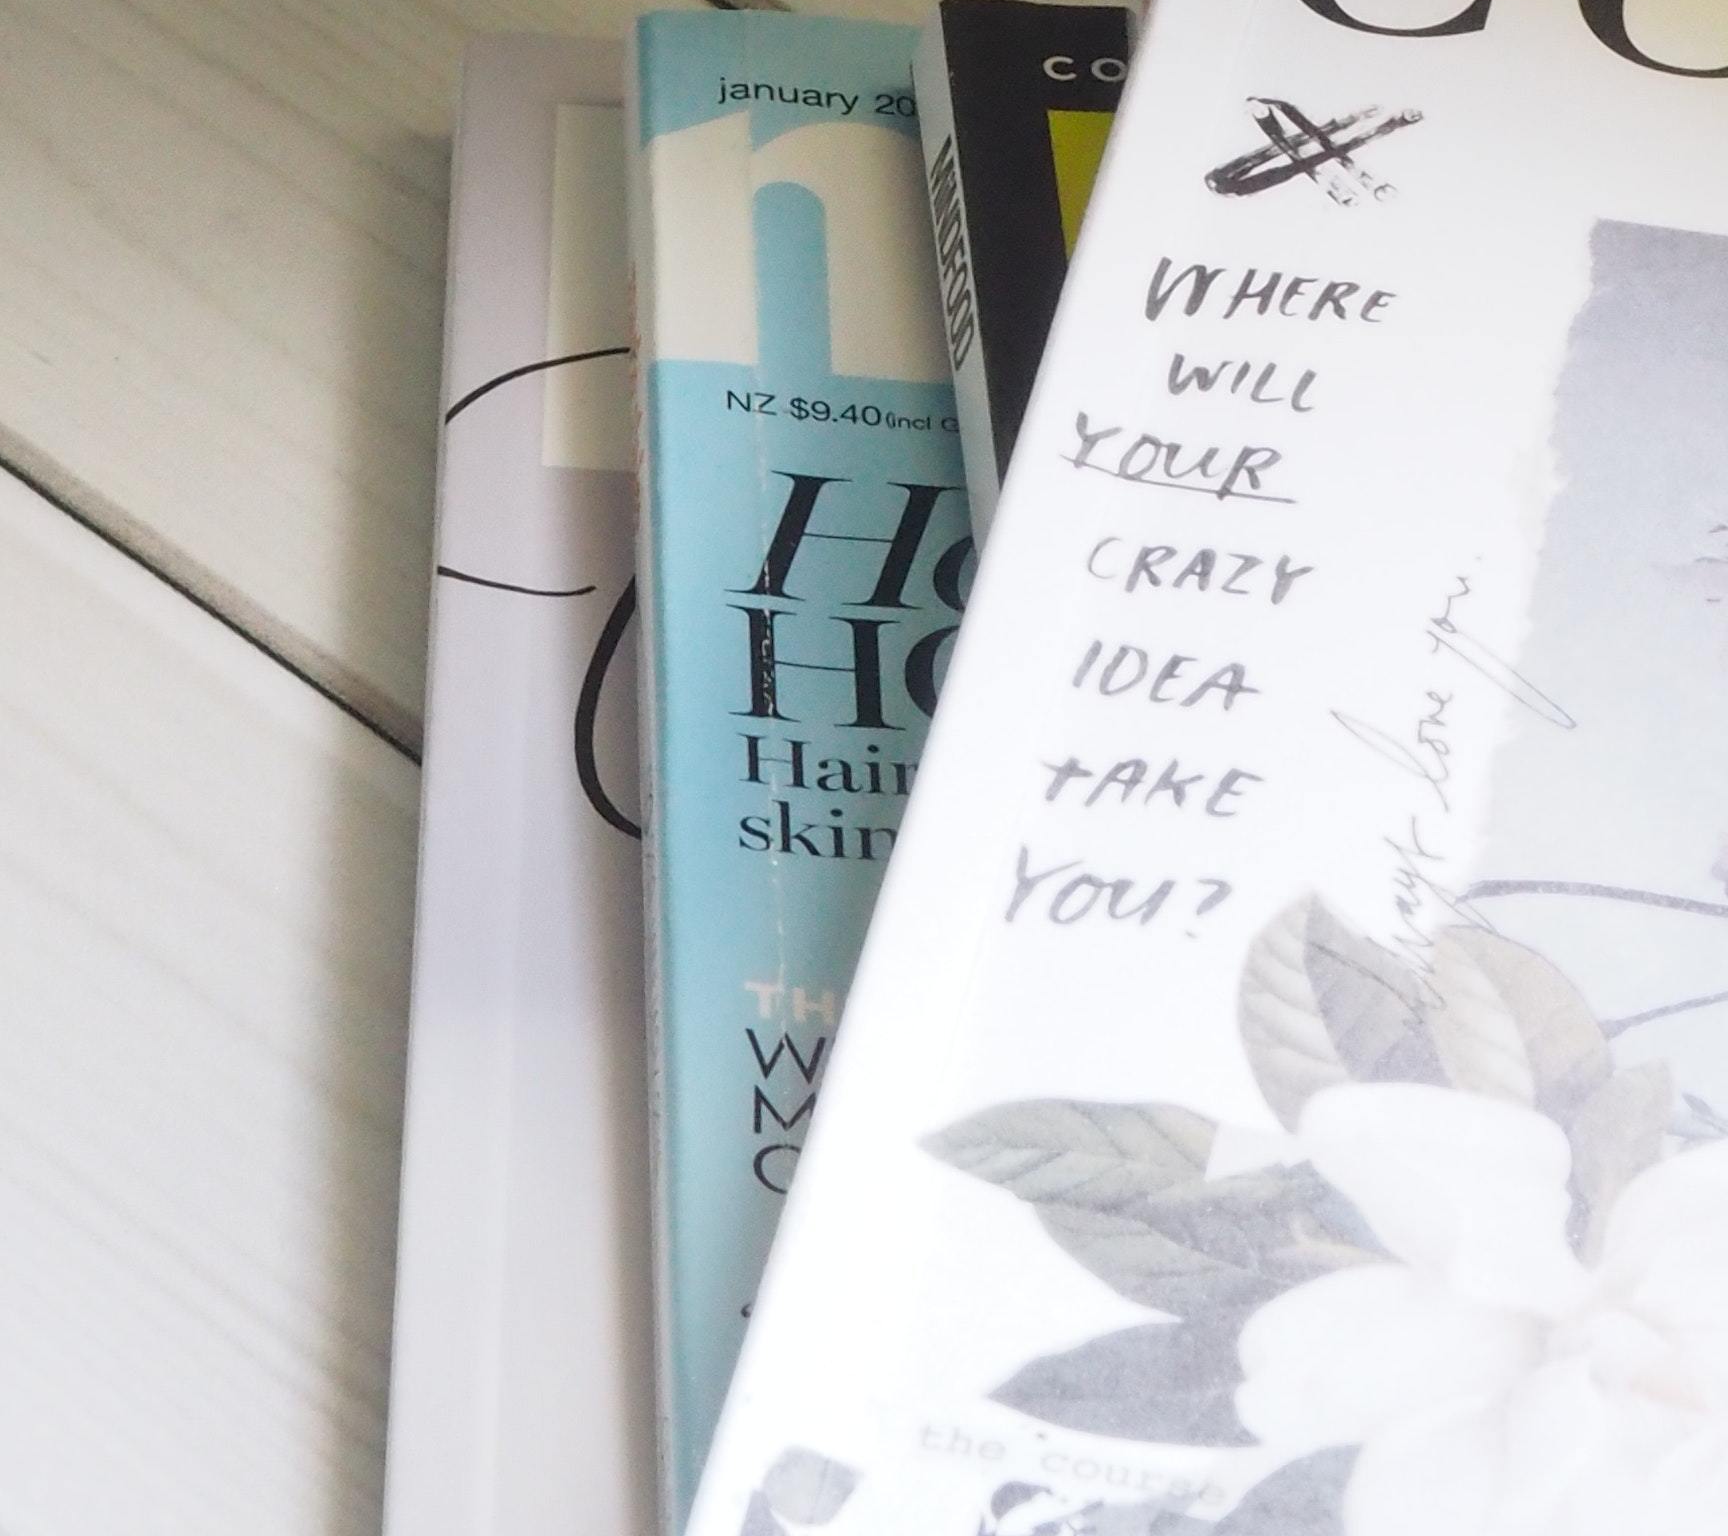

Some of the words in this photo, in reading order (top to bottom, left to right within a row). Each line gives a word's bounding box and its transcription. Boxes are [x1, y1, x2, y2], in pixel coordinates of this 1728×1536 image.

[718, 75, 859, 115] january
[1041, 55, 1129, 83] CO
[1143, 256, 1398, 323] WHERE
[726, 389, 778, 416] NZ
[1167, 352, 1318, 414] WILL
[1072, 410, 1284, 495] YOUR
[1086, 534, 1318, 606] CRAZY
[1070, 638, 1264, 713] IDEA
[737, 732, 920, 796] Hair
[738, 798, 899, 861] skin
[1002, 841, 1233, 941] YOU?
[919, 1424, 1008, 1462] the
